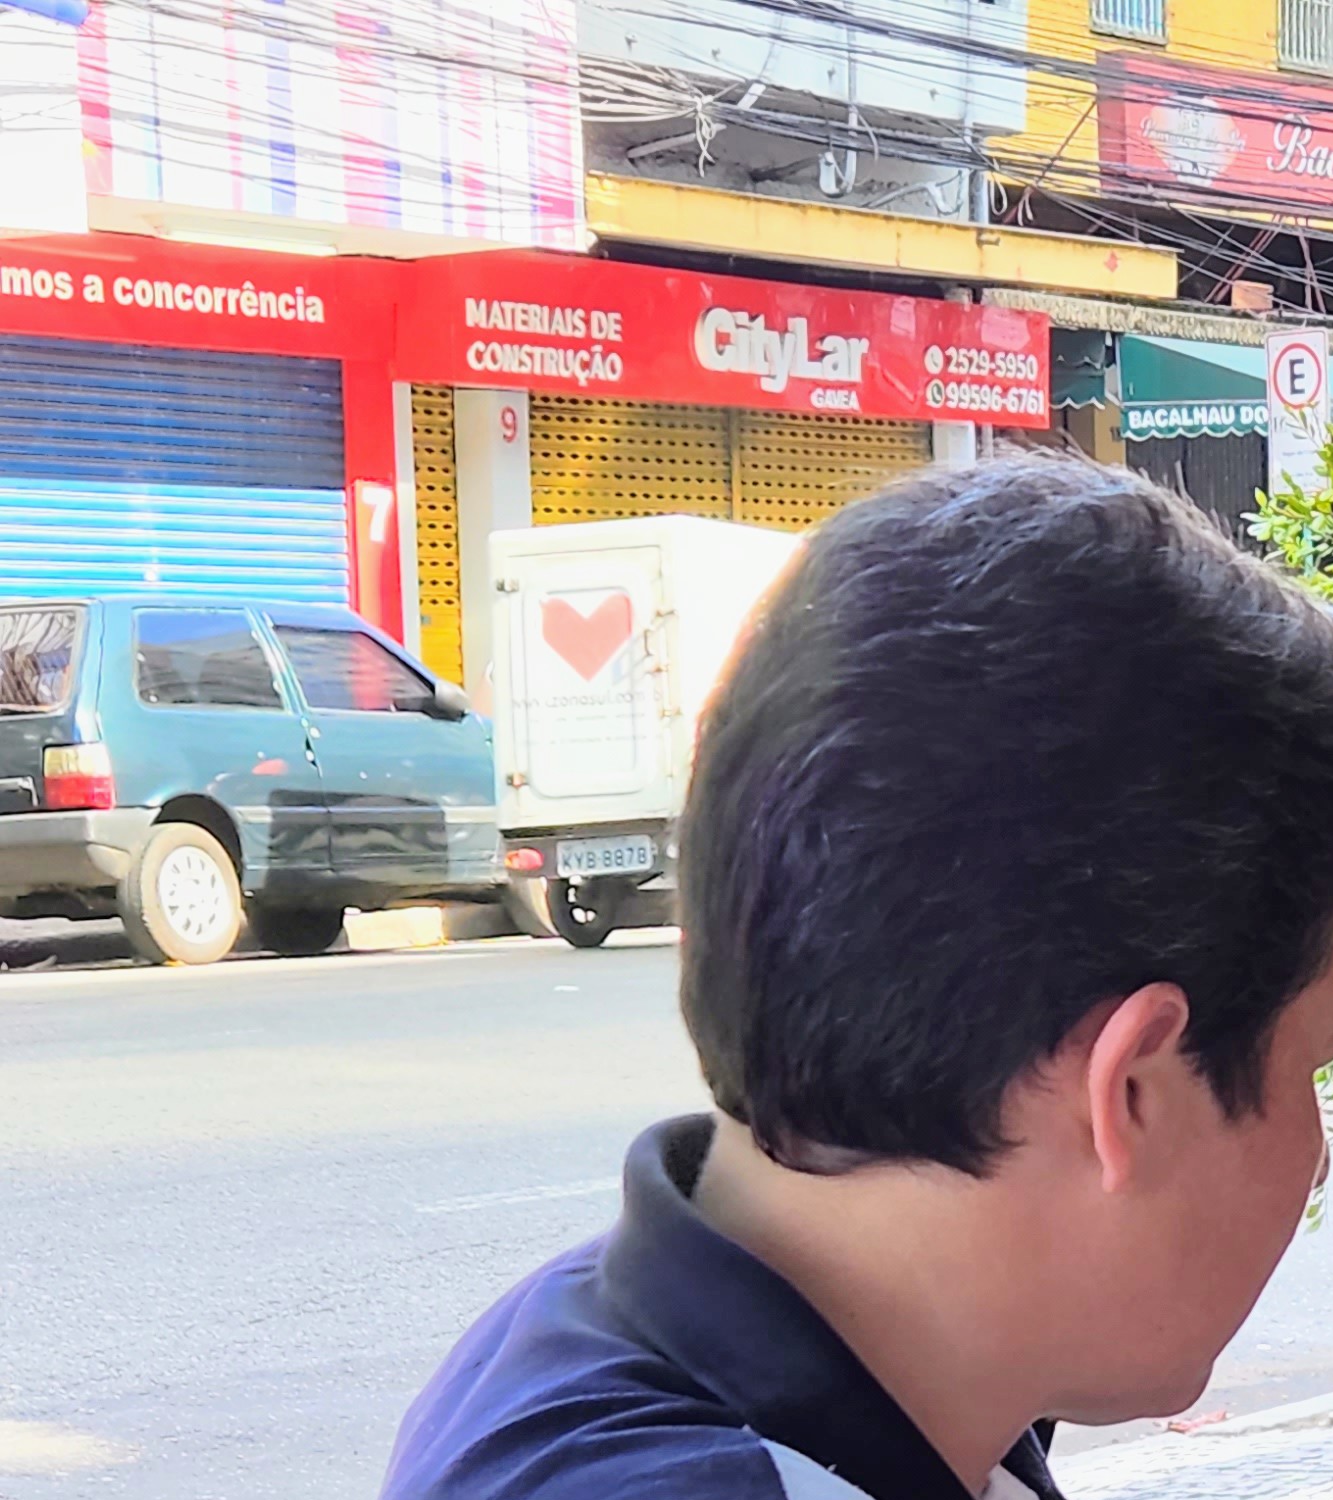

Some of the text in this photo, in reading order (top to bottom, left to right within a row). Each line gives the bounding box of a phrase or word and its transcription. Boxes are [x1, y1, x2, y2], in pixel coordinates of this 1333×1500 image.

[1, 265, 325, 323] mos a concorrência
[465, 297, 623, 342] MATERIAIS DE
[466, 340, 623, 387] CONSTRUÇÃO
[694, 306, 870, 394] CityLar
[945, 345, 1038, 380] 2529-5950
[1288, 357, 1306, 395] E
[945, 381, 1045, 415] 99596-6761
[1127, 405, 1236, 430] BACALHAU
[501, 406, 518, 443] 9
[362, 486, 393, 543] 7
